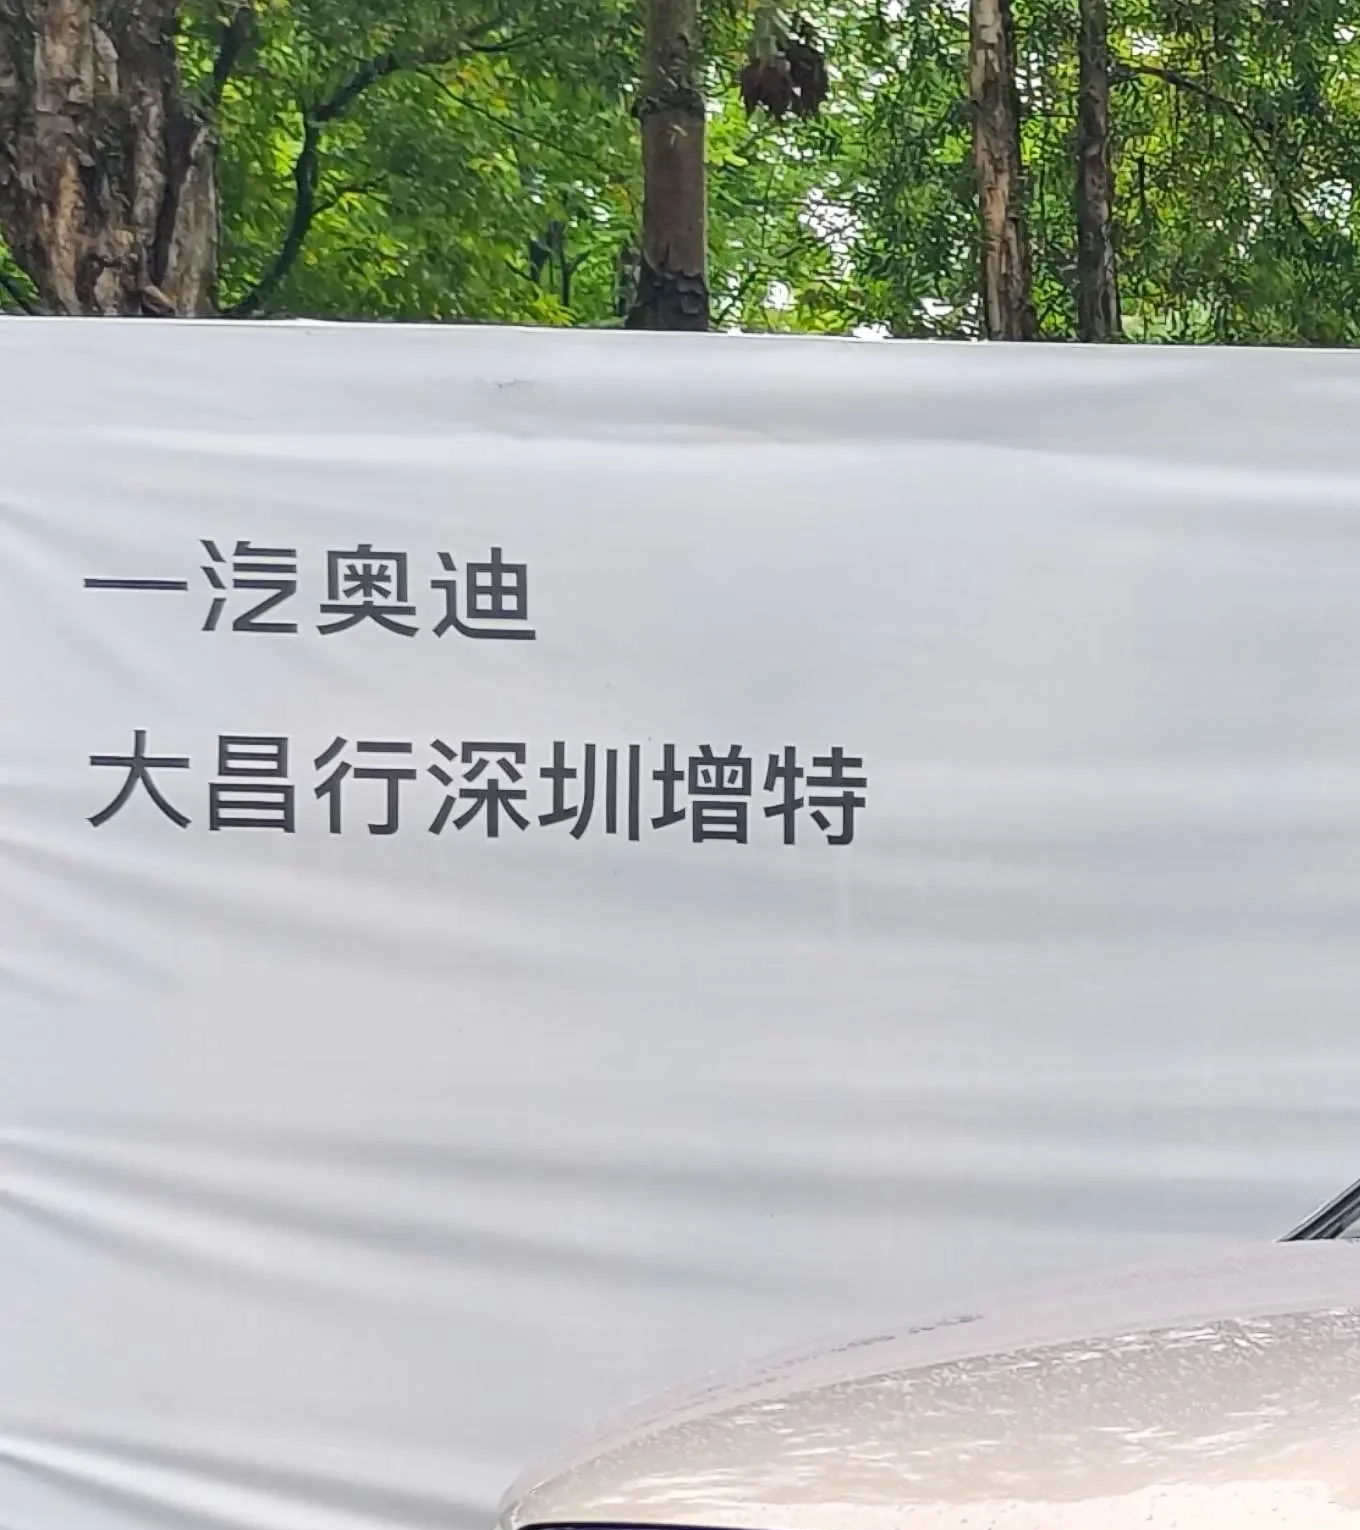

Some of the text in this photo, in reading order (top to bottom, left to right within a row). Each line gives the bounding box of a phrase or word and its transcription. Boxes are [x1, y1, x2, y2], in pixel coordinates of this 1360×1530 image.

[83, 539, 537, 641] 一汽奥迪
[86, 729, 868, 846] 大昌行深圳增特
